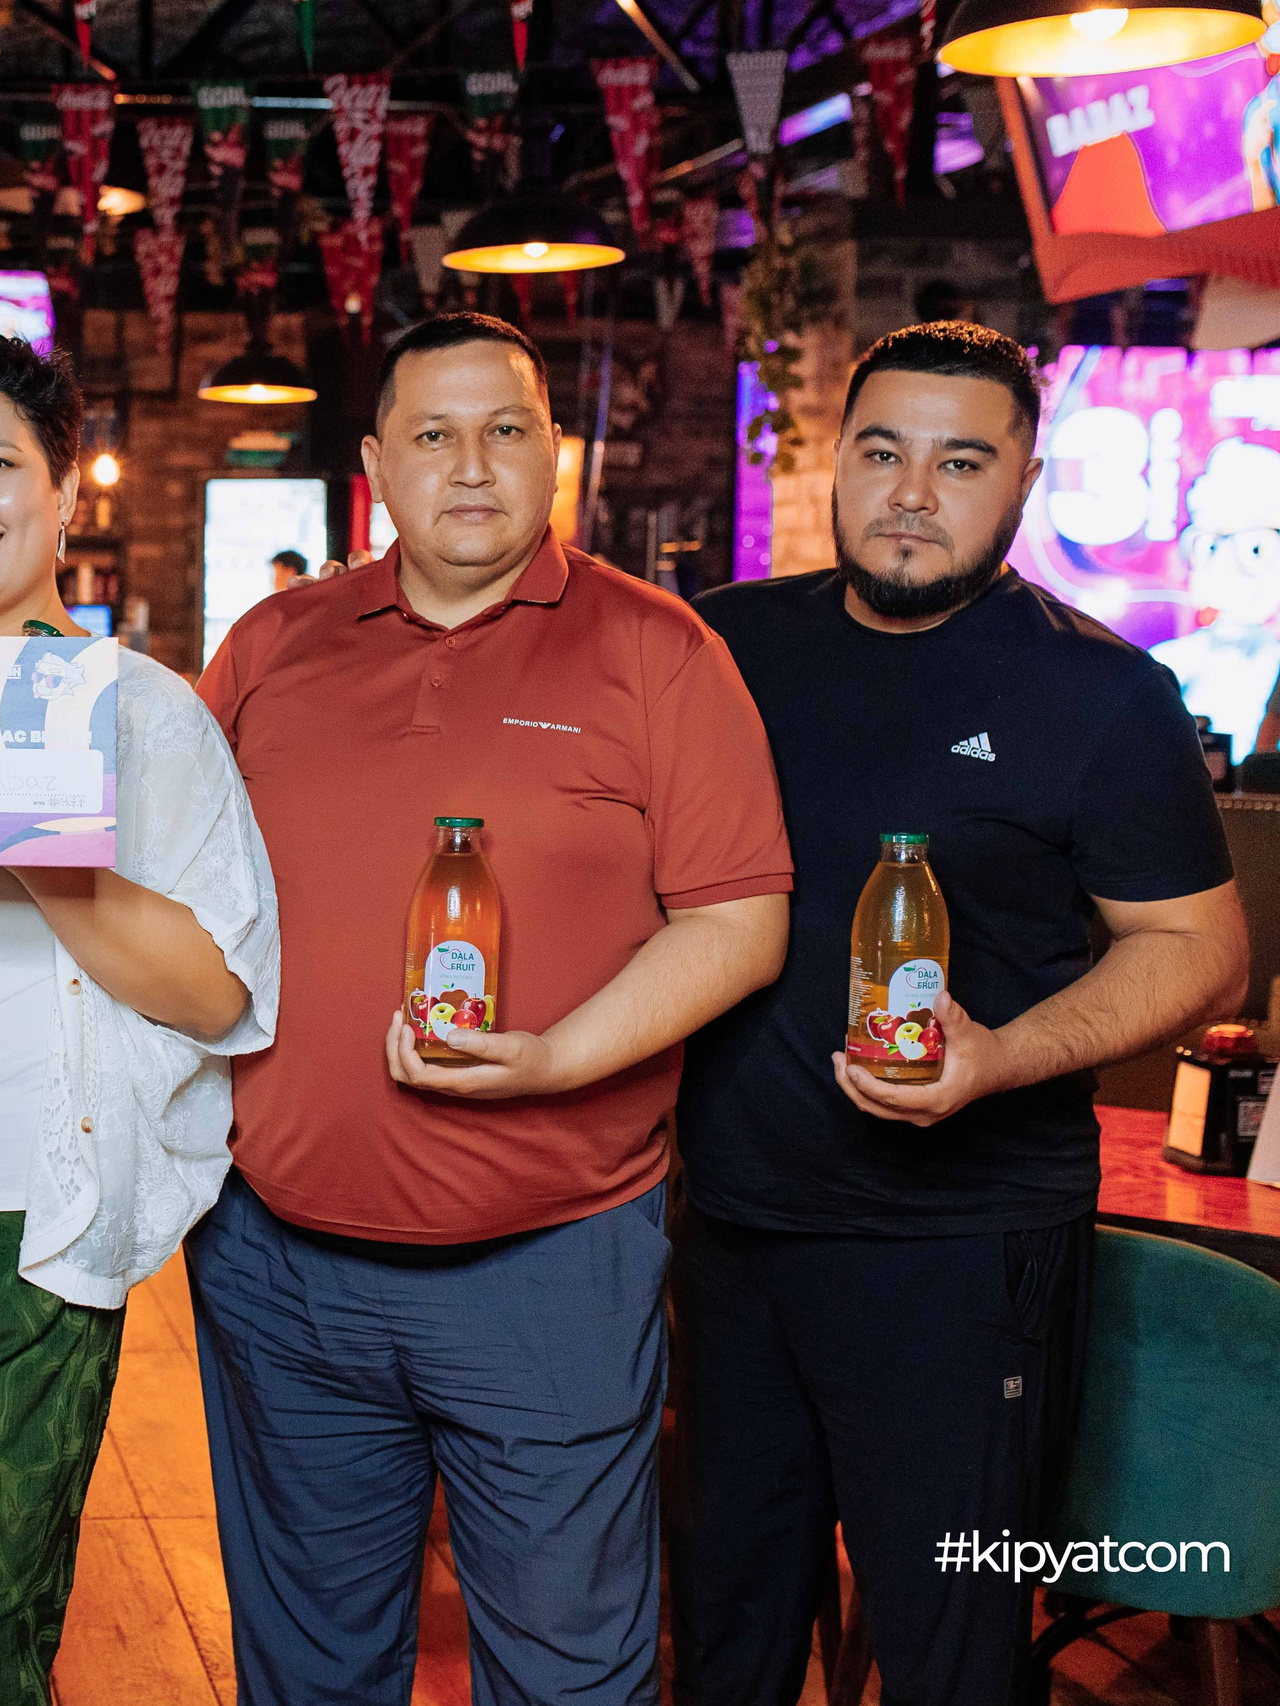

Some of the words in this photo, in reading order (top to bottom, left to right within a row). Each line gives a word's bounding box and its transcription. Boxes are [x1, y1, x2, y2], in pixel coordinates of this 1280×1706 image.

[502, 717, 539, 728] EMPORIO
[549, 723, 582, 734] ARMANI
[950, 744, 996, 762] adidas
[451, 951, 474, 960] DALA
[450, 963, 476, 972] FRUIT
[917, 970, 938, 979] DALA
[917, 981, 939, 990] FRUIT
